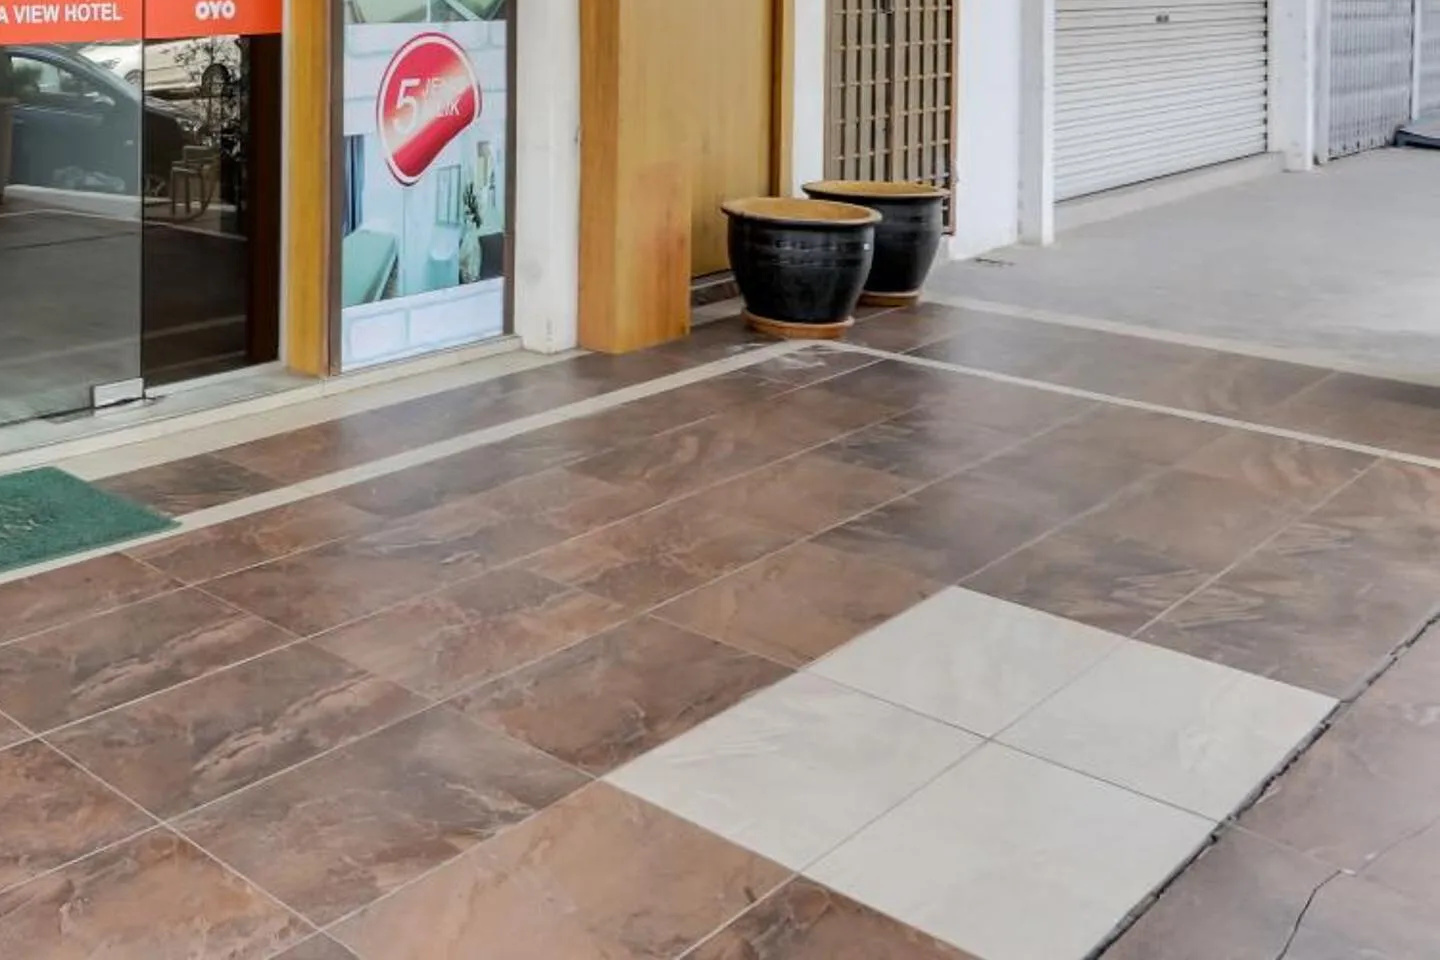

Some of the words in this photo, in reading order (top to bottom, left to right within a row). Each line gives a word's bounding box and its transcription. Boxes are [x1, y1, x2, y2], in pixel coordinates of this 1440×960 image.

[13, 4, 60, 24] VIEW
[64, 2, 123, 22] HOTEL
[195, 0, 236, 20] OYO
